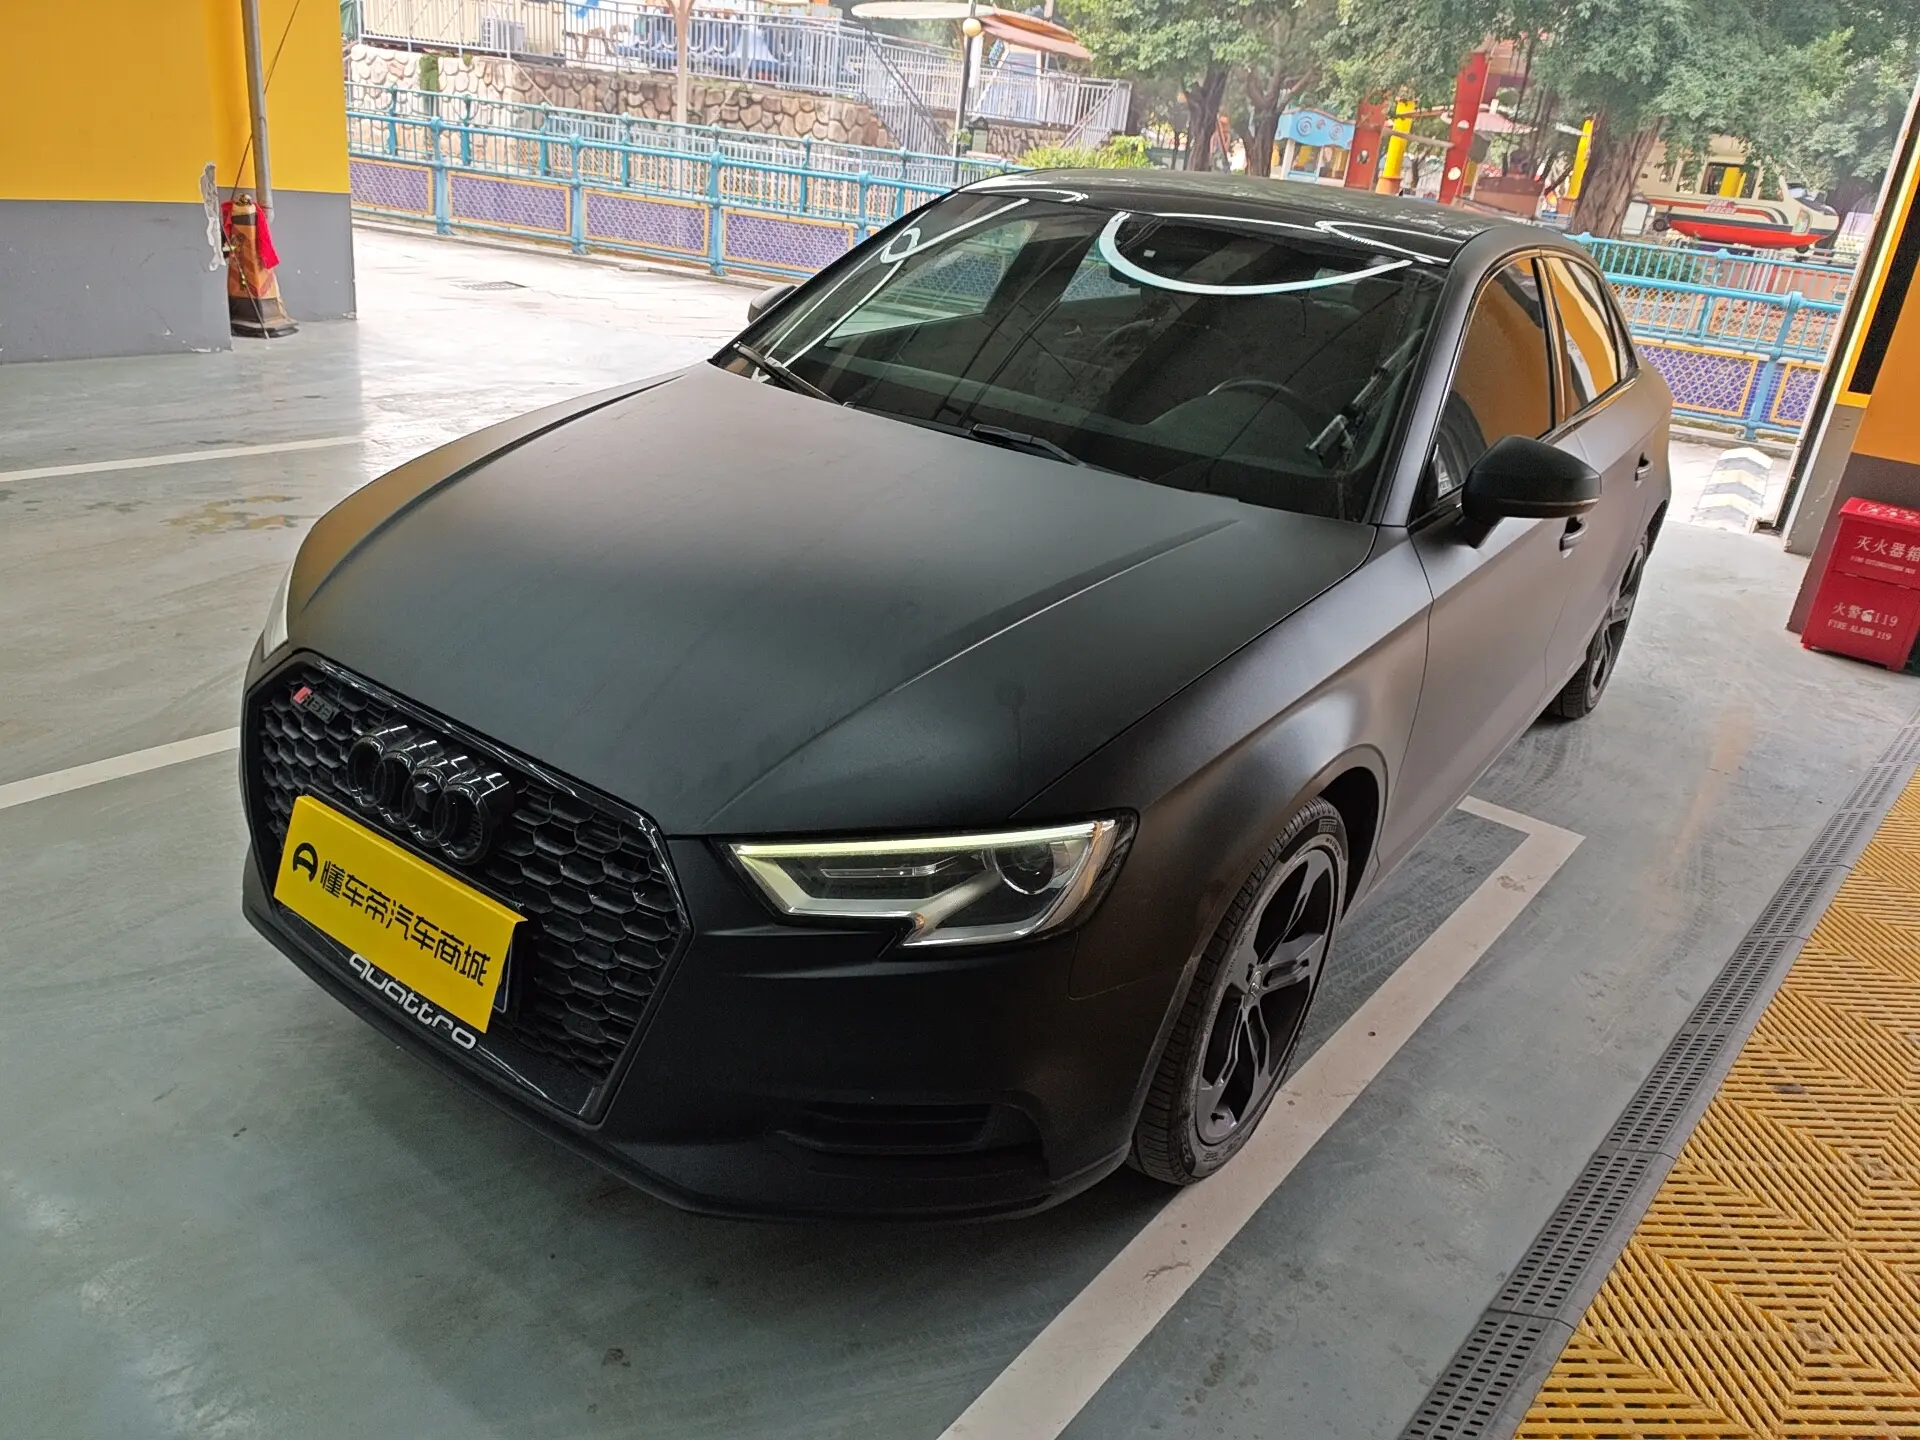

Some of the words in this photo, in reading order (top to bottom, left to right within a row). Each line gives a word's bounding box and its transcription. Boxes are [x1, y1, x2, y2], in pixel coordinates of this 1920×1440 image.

[1854, 535, 1920, 562] 灭火器箱
[1831, 602, 1862, 619] 火警
[1873, 612, 1899, 627] 119
[1827, 619, 1848, 630] FIRE
[1849, 624, 1875, 636] ALARM
[1876, 631, 1892, 640] 119
[320, 860, 491, 987] 懂车帝汽车商城
[349, 953, 477, 1050] quattro
